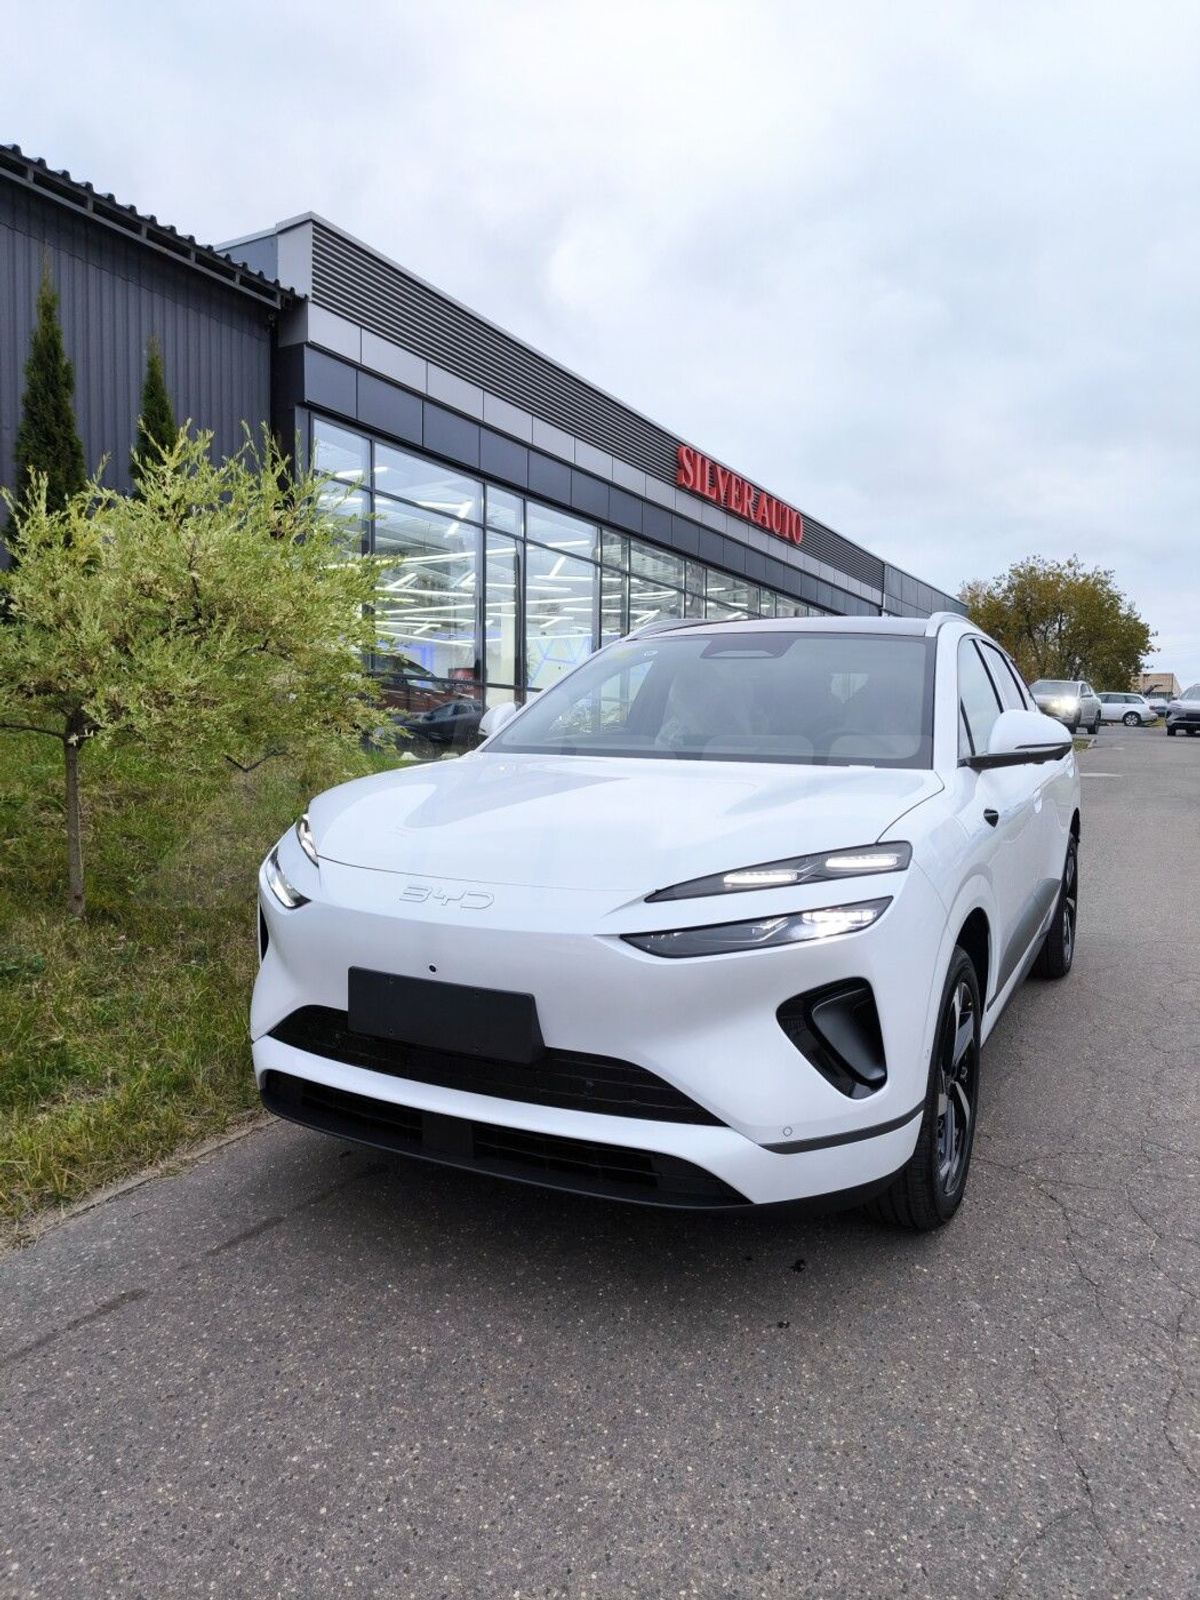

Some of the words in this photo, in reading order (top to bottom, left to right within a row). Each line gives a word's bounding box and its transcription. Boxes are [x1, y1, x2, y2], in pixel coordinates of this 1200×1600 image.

[677, 444, 756, 521] SILVER
[755, 492, 804, 545] AUTO
[398, 885, 495, 910] BYD
